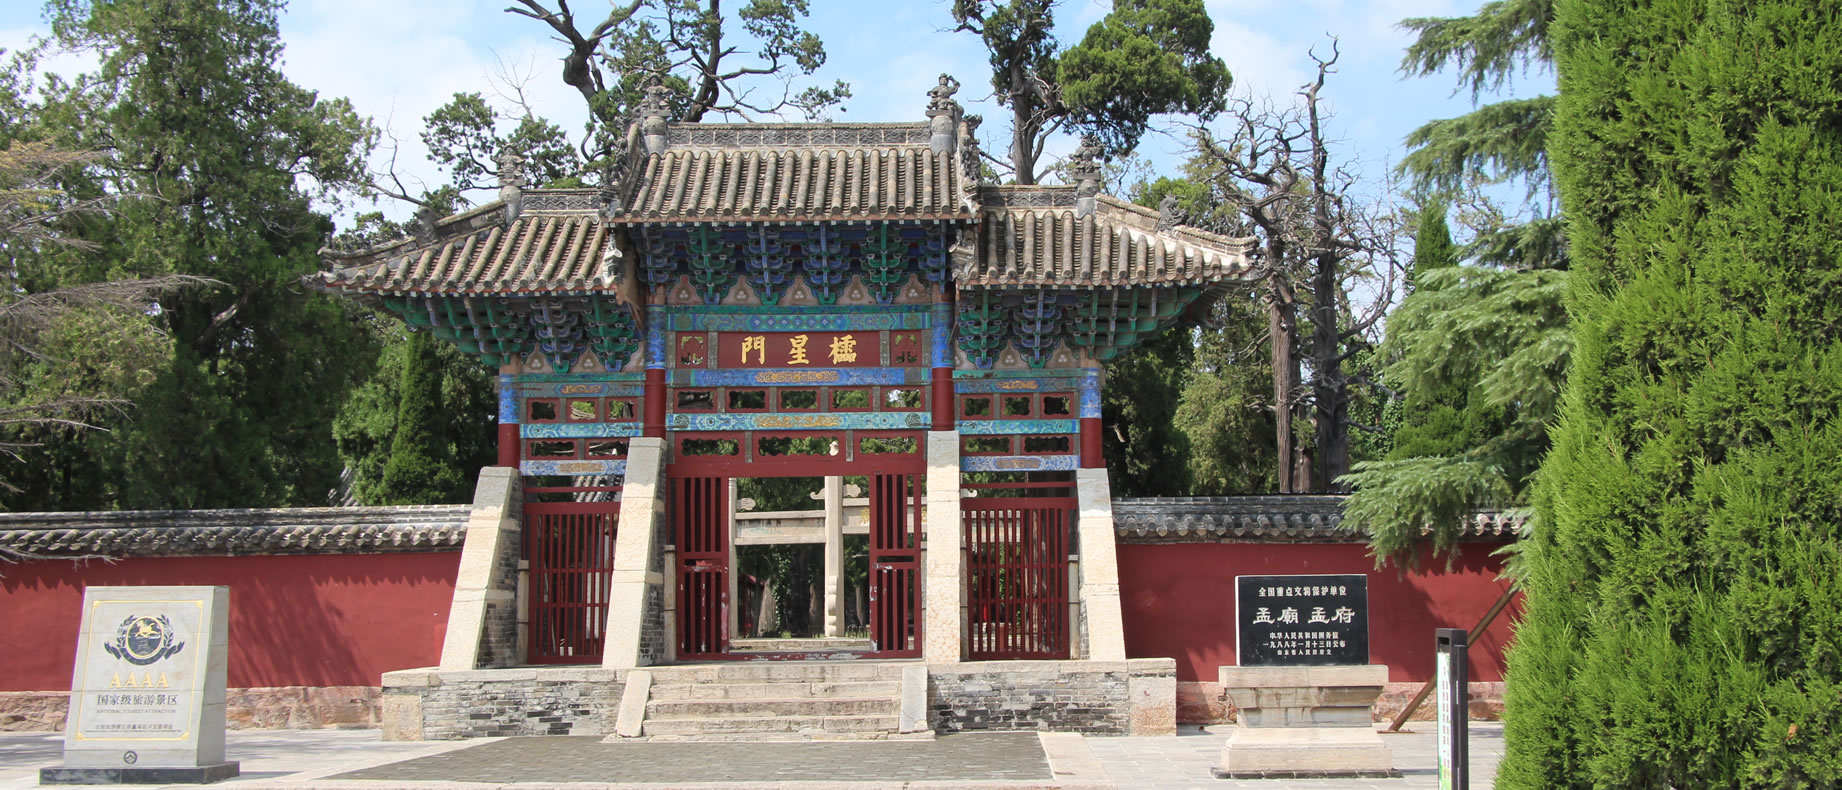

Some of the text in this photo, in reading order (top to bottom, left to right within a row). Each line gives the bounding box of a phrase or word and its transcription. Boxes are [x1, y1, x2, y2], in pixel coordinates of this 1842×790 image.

[1258, 586, 1347, 597] 全国重点文物保护单位
[1307, 606, 1356, 624] 孟府
[1269, 632, 1339, 640] 中华人民共和国国务院
[1262, 640, 1346, 648] 一九八八年一月十三日公布
[108, 671, 169, 688] AAAA
[97, 694, 178, 706] 国家级旅游景区
